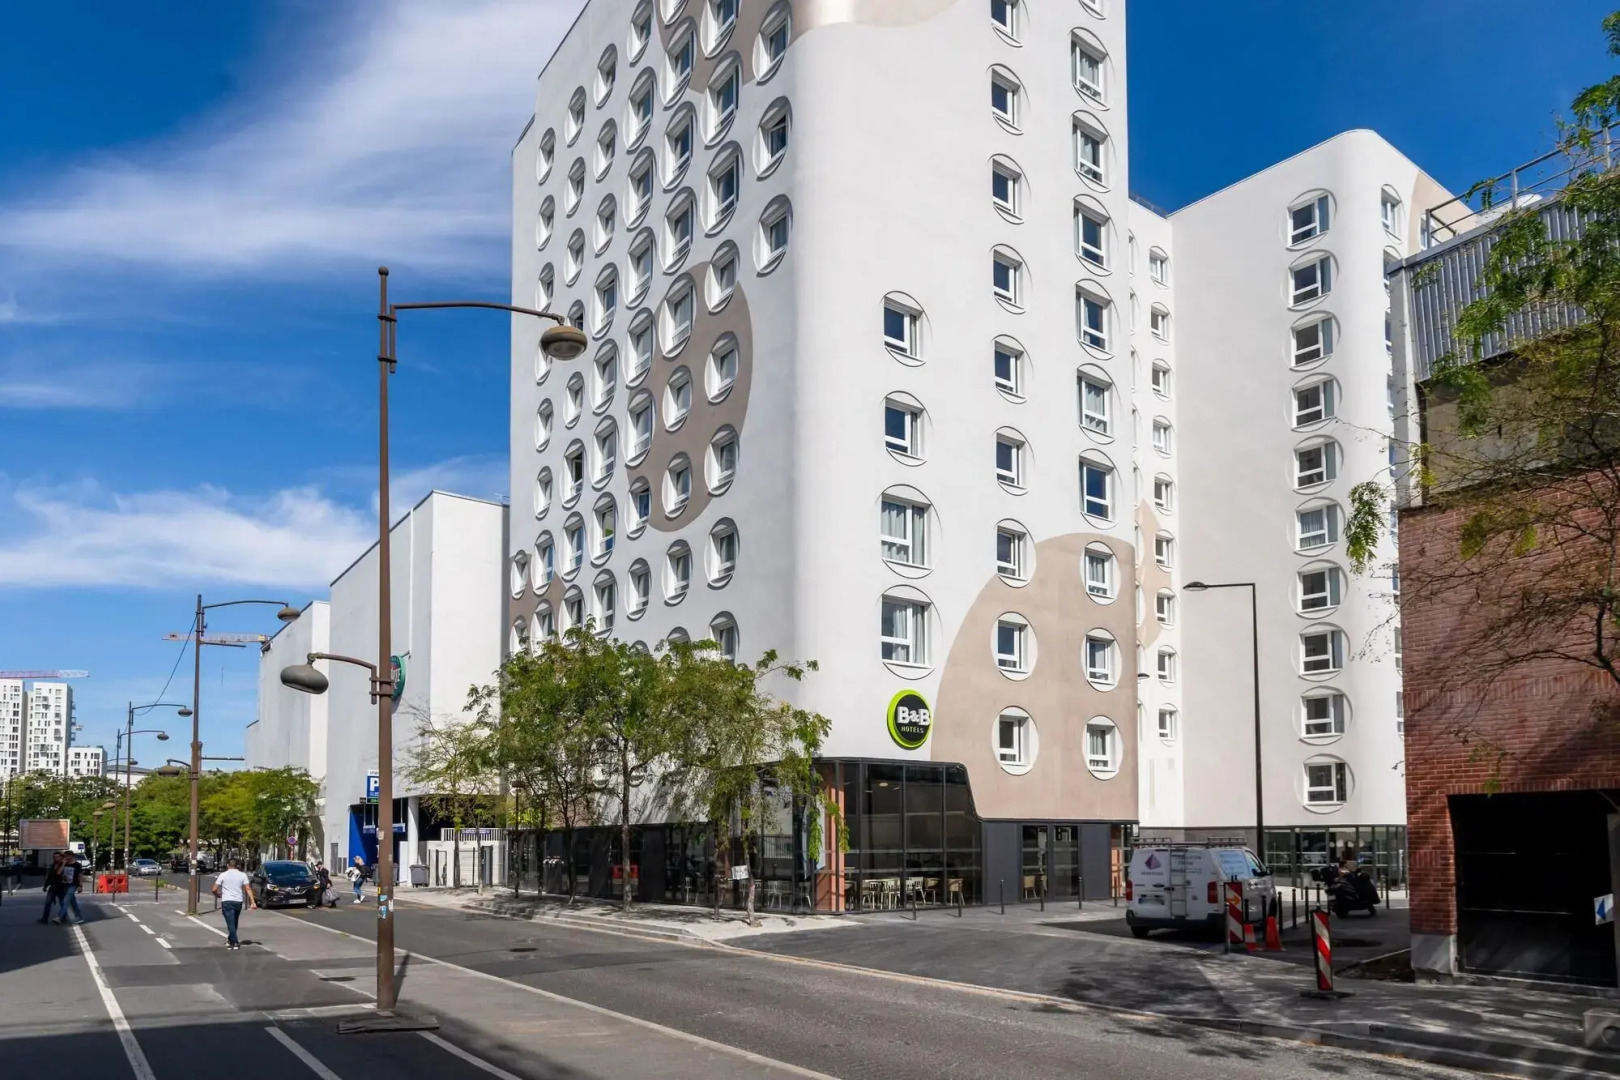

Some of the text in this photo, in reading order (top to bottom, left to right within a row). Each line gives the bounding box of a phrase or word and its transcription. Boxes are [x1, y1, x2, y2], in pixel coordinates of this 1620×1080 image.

[897, 706, 931, 726] B&B
[901, 726, 924, 734] HOTELS
[370, 777, 380, 792] P
